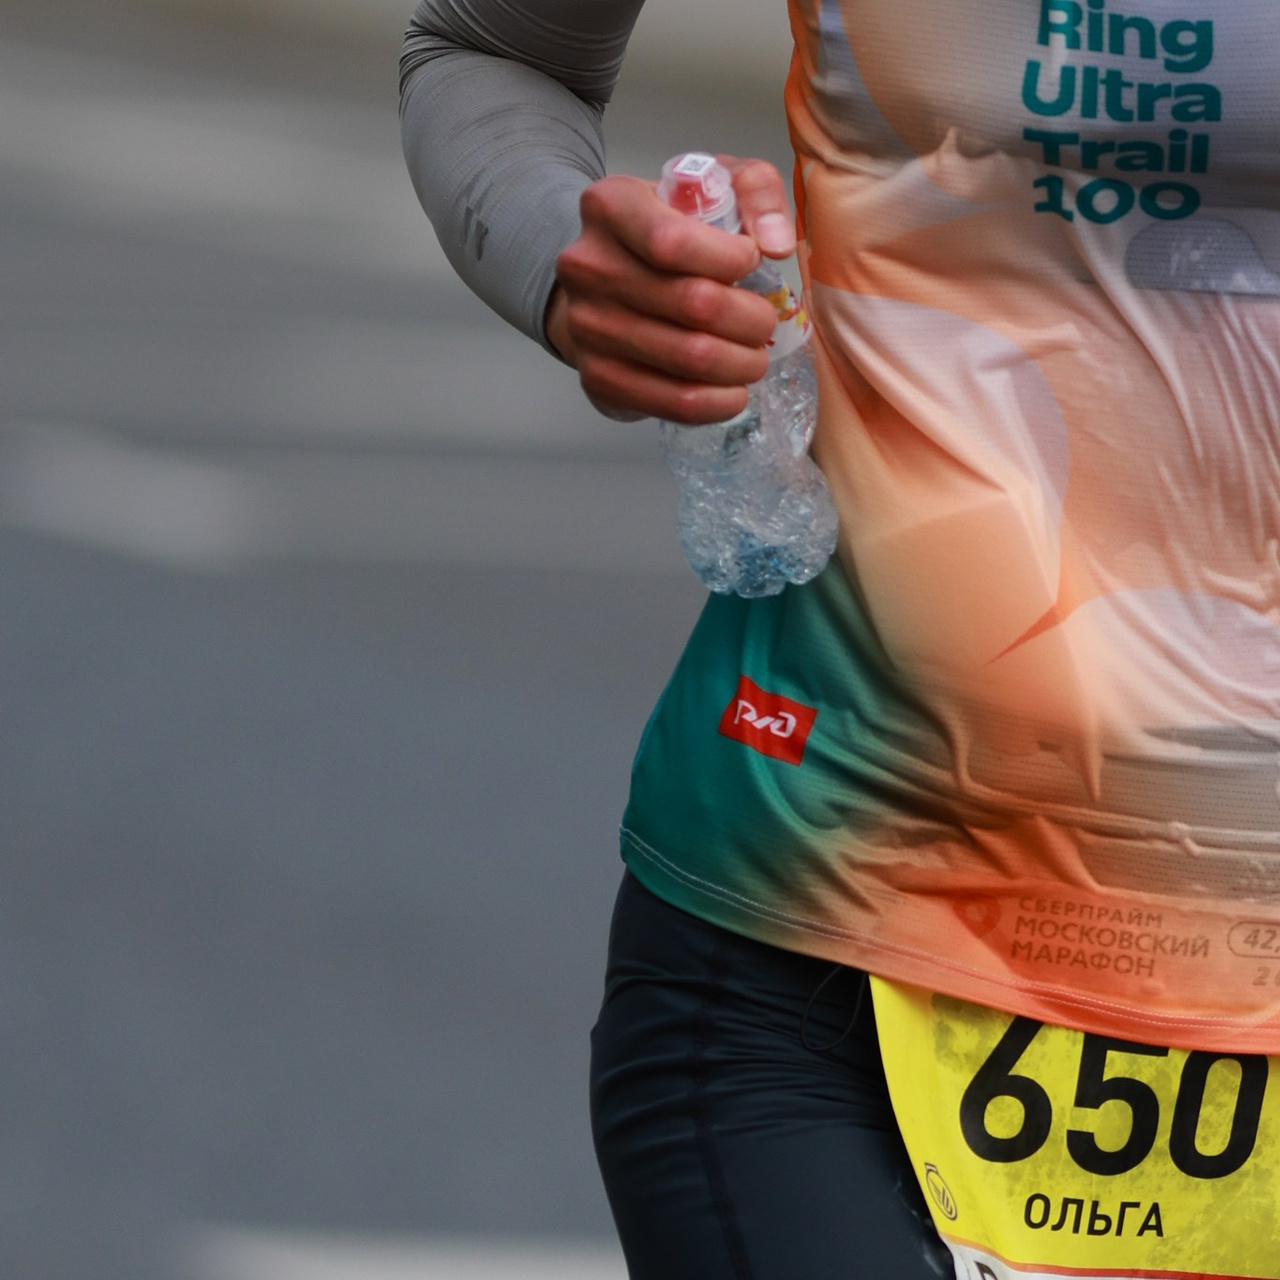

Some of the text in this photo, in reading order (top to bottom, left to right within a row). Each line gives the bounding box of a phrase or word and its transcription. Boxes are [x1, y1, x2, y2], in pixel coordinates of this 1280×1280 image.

[1021, 59, 1222, 122] Ultra
[1022, 128, 1210, 174] Trail
[1033, 174, 1201, 225] 100
[1019, 896, 1163, 929] СБЕРПРАЙМ
[1010, 940, 1155, 977] МАРАФОН
[1014, 916, 1210, 958] МОСКОВСКИЙ
[959, 1016, 1269, 1180] 650
[1023, 1193, 1164, 1238] ОЛЬГА
